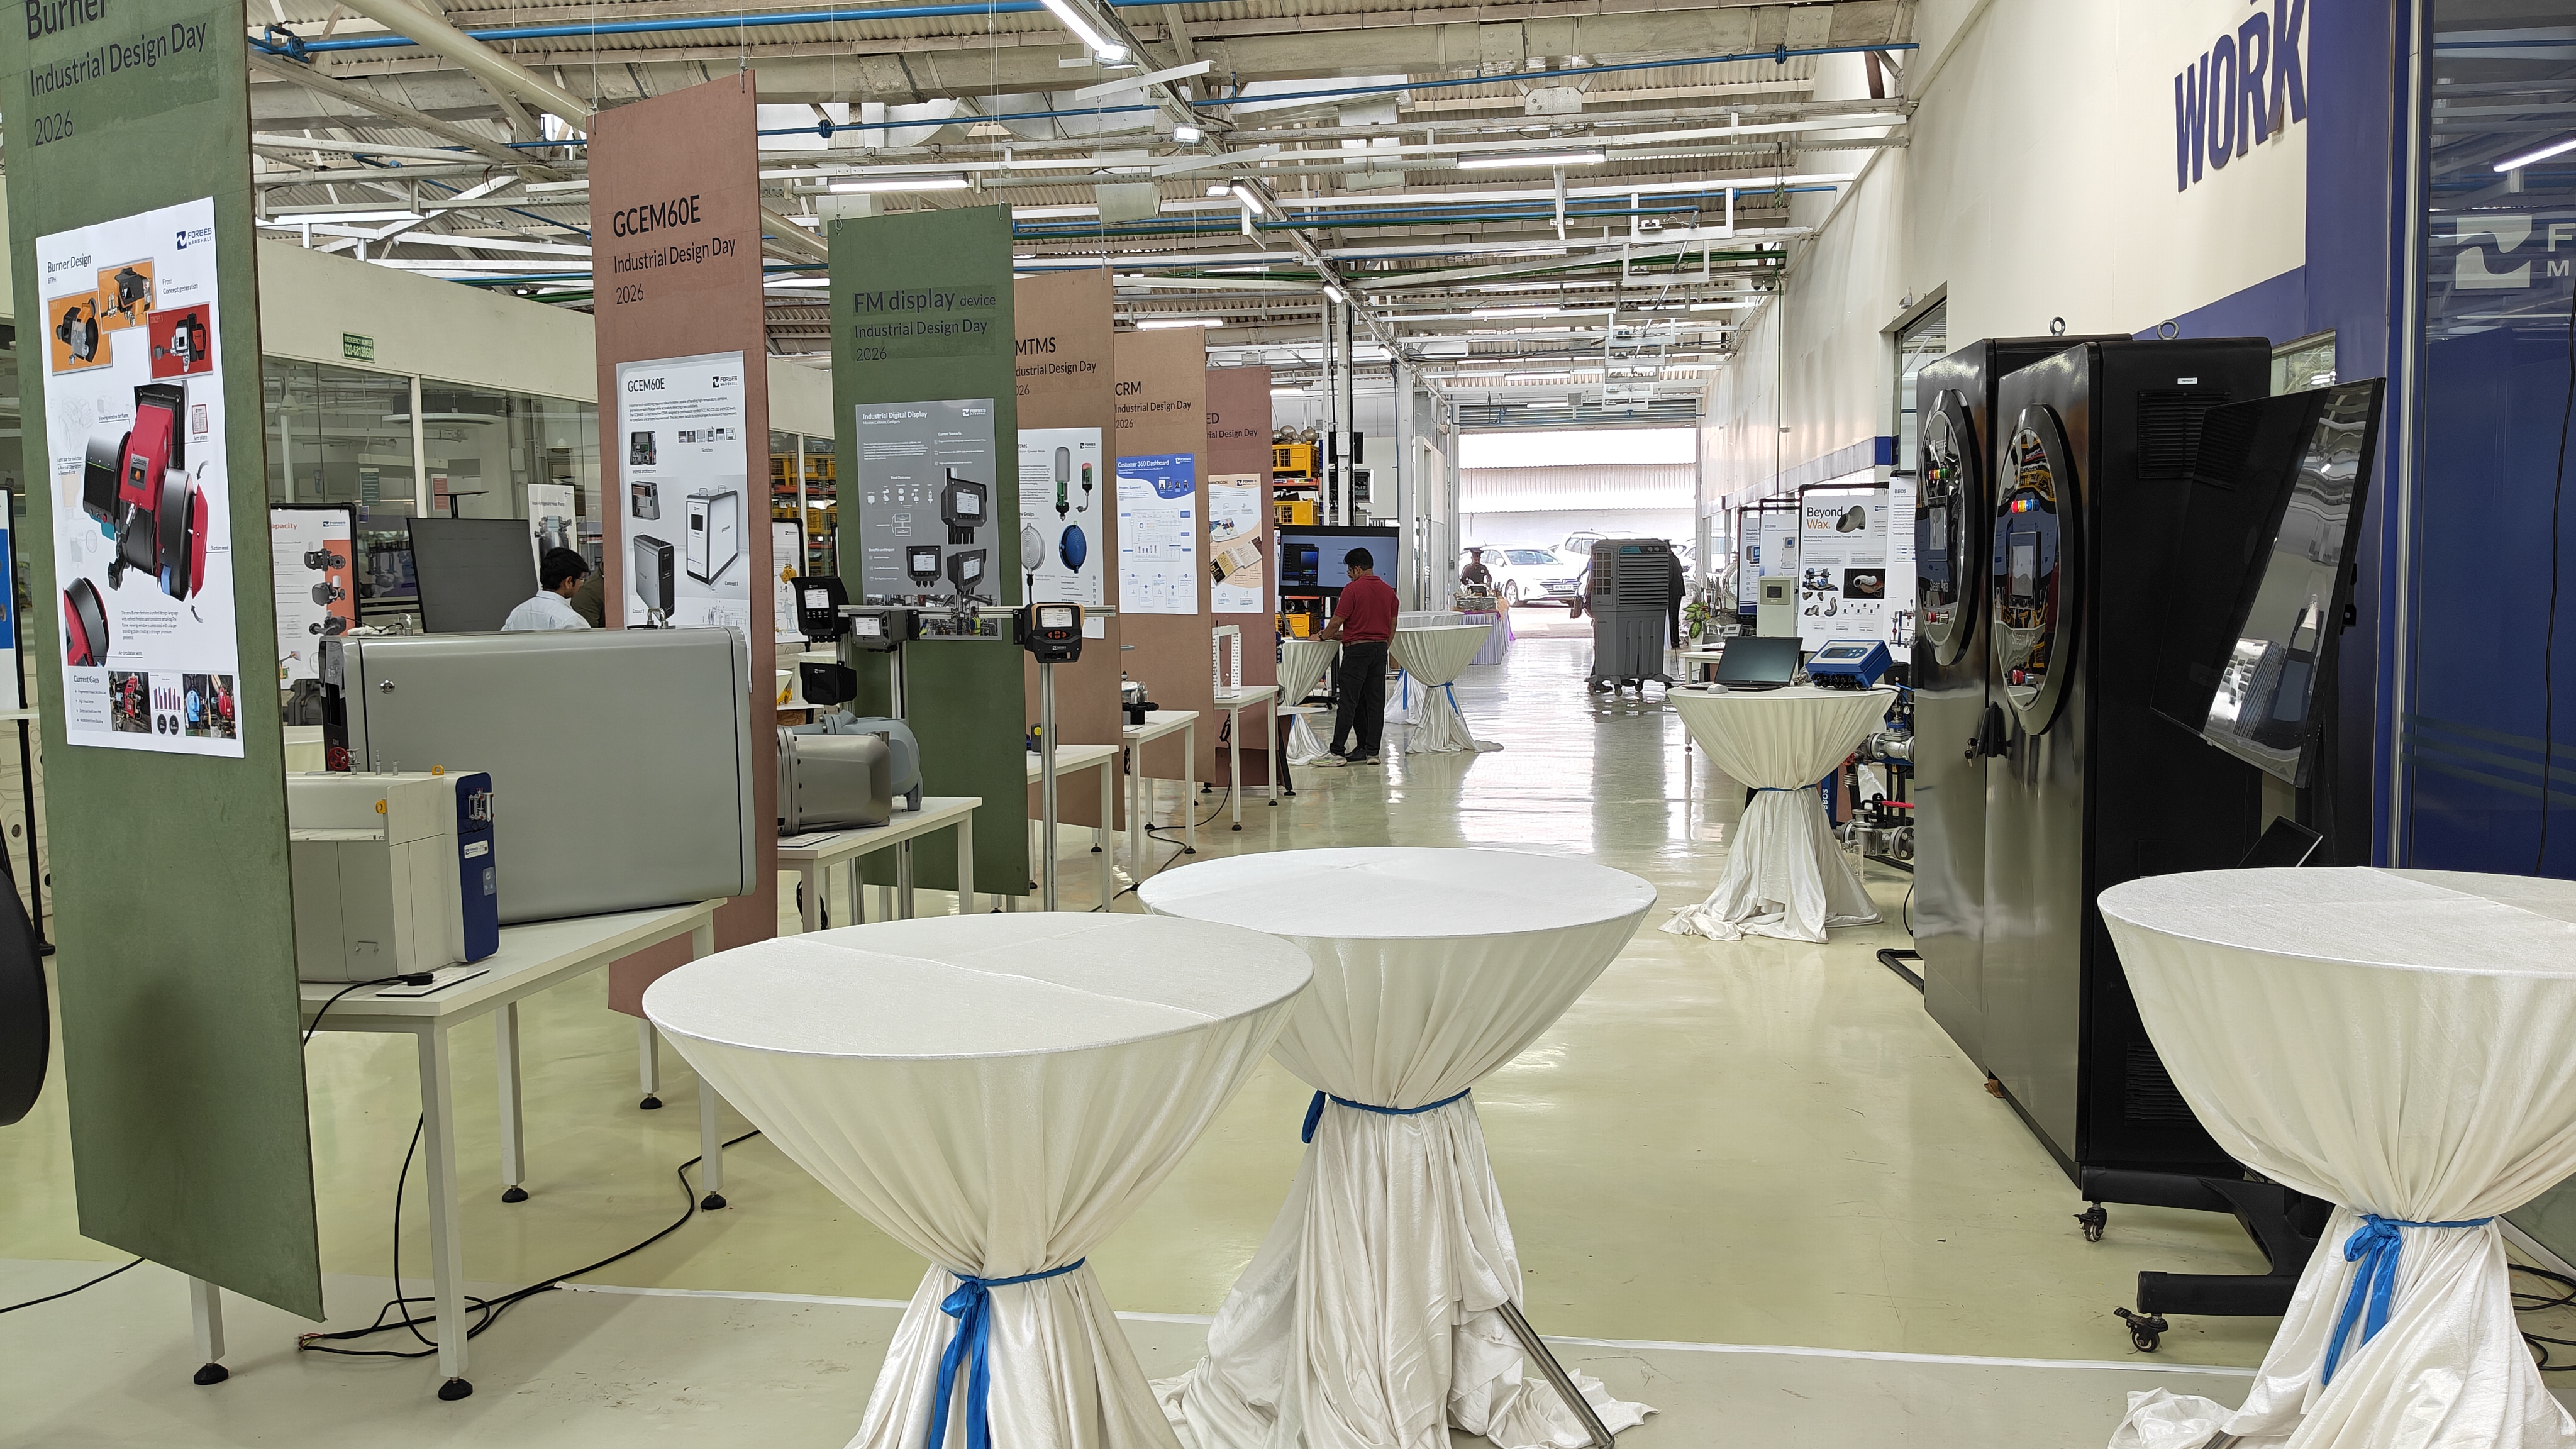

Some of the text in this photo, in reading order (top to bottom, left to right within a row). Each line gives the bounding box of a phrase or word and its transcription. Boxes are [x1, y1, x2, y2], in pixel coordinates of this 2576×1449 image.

[31, 22, 206, 97] Industrial Design Day
[2175, 0, 2307, 194] WORK
[35, 109, 74, 147] 2026
[613, 194, 701, 238] GCEM60E
[187, 227, 212, 239] FORBES
[188, 236, 213, 245] MARSHALL
[614, 236, 736, 274] Industrial Design Day
[48, 253, 92, 273] Burner Design
[163, 283, 199, 295] Concept generation
[616, 283, 644, 305] 2026
[854, 288, 996, 313] FM display device
[855, 319, 987, 338] Industrial Design Day
[1015, 336, 1057, 357] MTMS
[856, 347, 887, 362] 2026
[1016, 360, 1097, 377] dustrial Design Day
[628, 377, 665, 392] GCEM60E
[1016, 384, 1030, 396] 26
[1115, 381, 1141, 396] CRM
[1115, 399, 1192, 414] Industrial Design Day
[889, 411, 907, 420] Digital
[907, 411, 928, 419] Display
[1206, 413, 1219, 425] ED
[1116, 419, 1134, 429] 2026
[1219, 429, 1243, 439] Design
[1244, 428, 1258, 437] Day
[1807, 506, 1843, 519] Beyond
[272, 522, 297, 530] apacity
[1806, 519, 1831, 530] Wax.
[74, 675, 99, 684] Current Gaps
